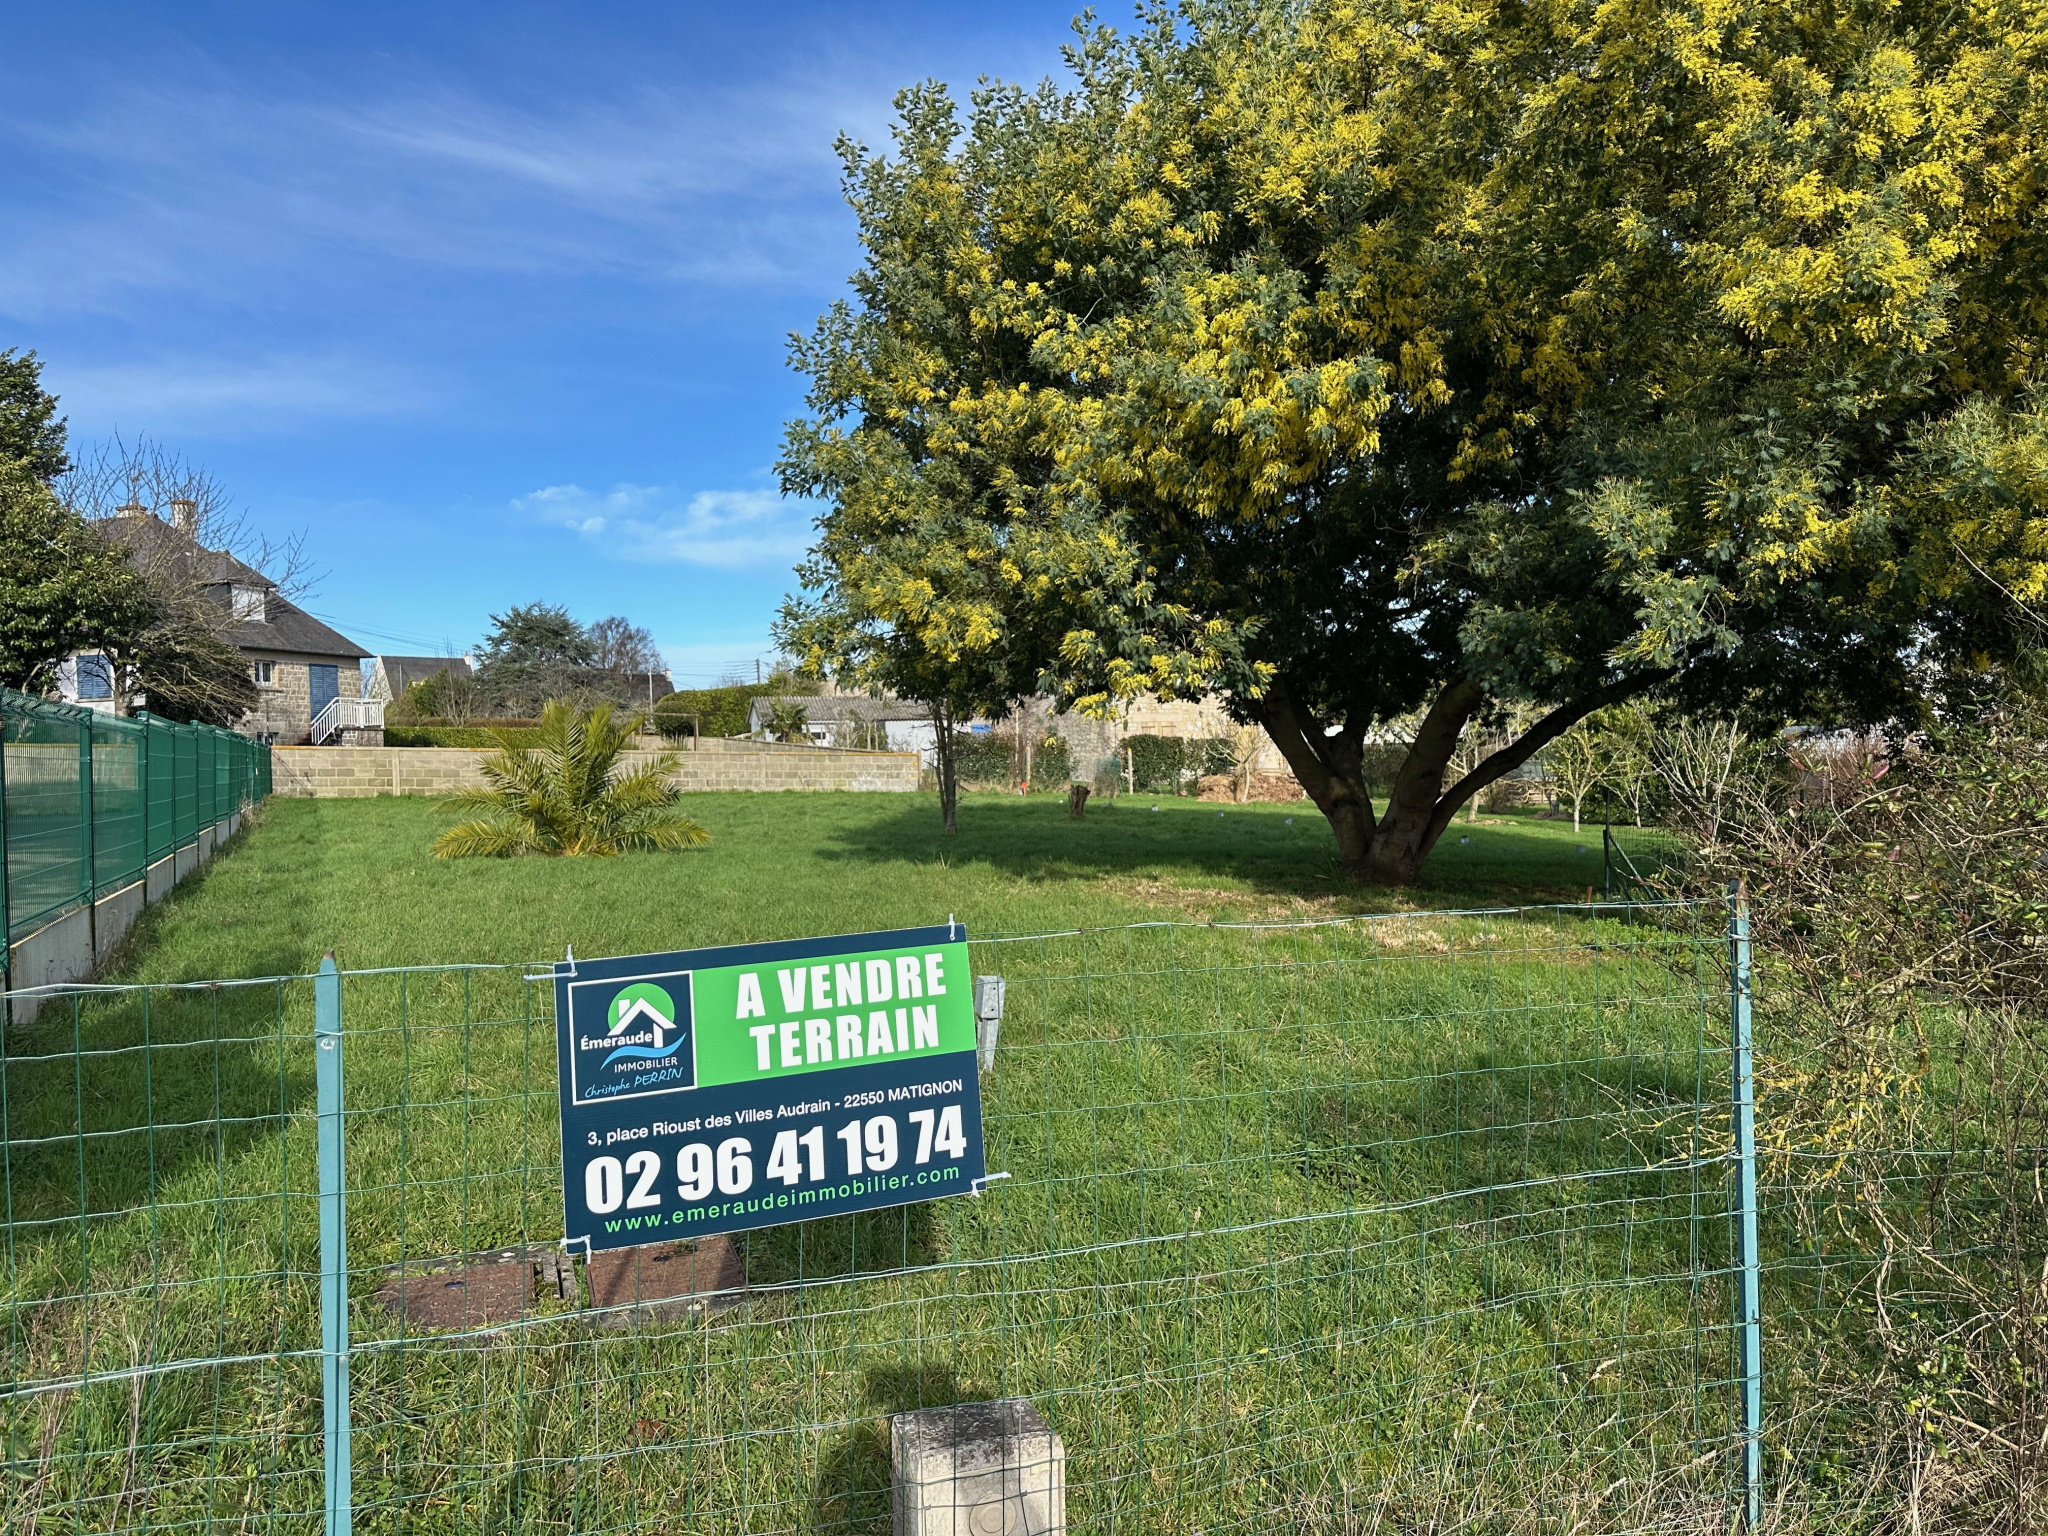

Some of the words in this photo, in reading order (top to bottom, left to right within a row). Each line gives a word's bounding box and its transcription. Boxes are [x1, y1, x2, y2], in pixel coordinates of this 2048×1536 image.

[736, 973, 765, 1019] A
[777, 953, 946, 1013] VENDRE
[580, 1033, 653, 1051] Émeraude
[614, 1057, 678, 1073] IMMOBILIER
[749, 1005, 939, 1071] TERRAIN
[584, 1080, 631, 1099] Christophe
[634, 1067, 684, 1087] PERRIN
[587, 1132, 603, 1146] 3,
[607, 1126, 648, 1144] place
[653, 1118, 701, 1135] Rioust
[705, 1114, 732, 1128] des
[735, 1108, 773, 1124] Villes
[776, 1100, 831, 1118] Audrain
[844, 1092, 885, 1108] 22550
[888, 1080, 963, 1102] MATIGNON
[584, 1150, 661, 1214] 02
[676, 1137, 753, 1200] 96
[766, 1126, 826, 1185] 41
[837, 1115, 898, 1175] 19
[909, 1105, 967, 1164] 74
[605, 1165, 959, 1233] www.emeraudeimmobilier.com
